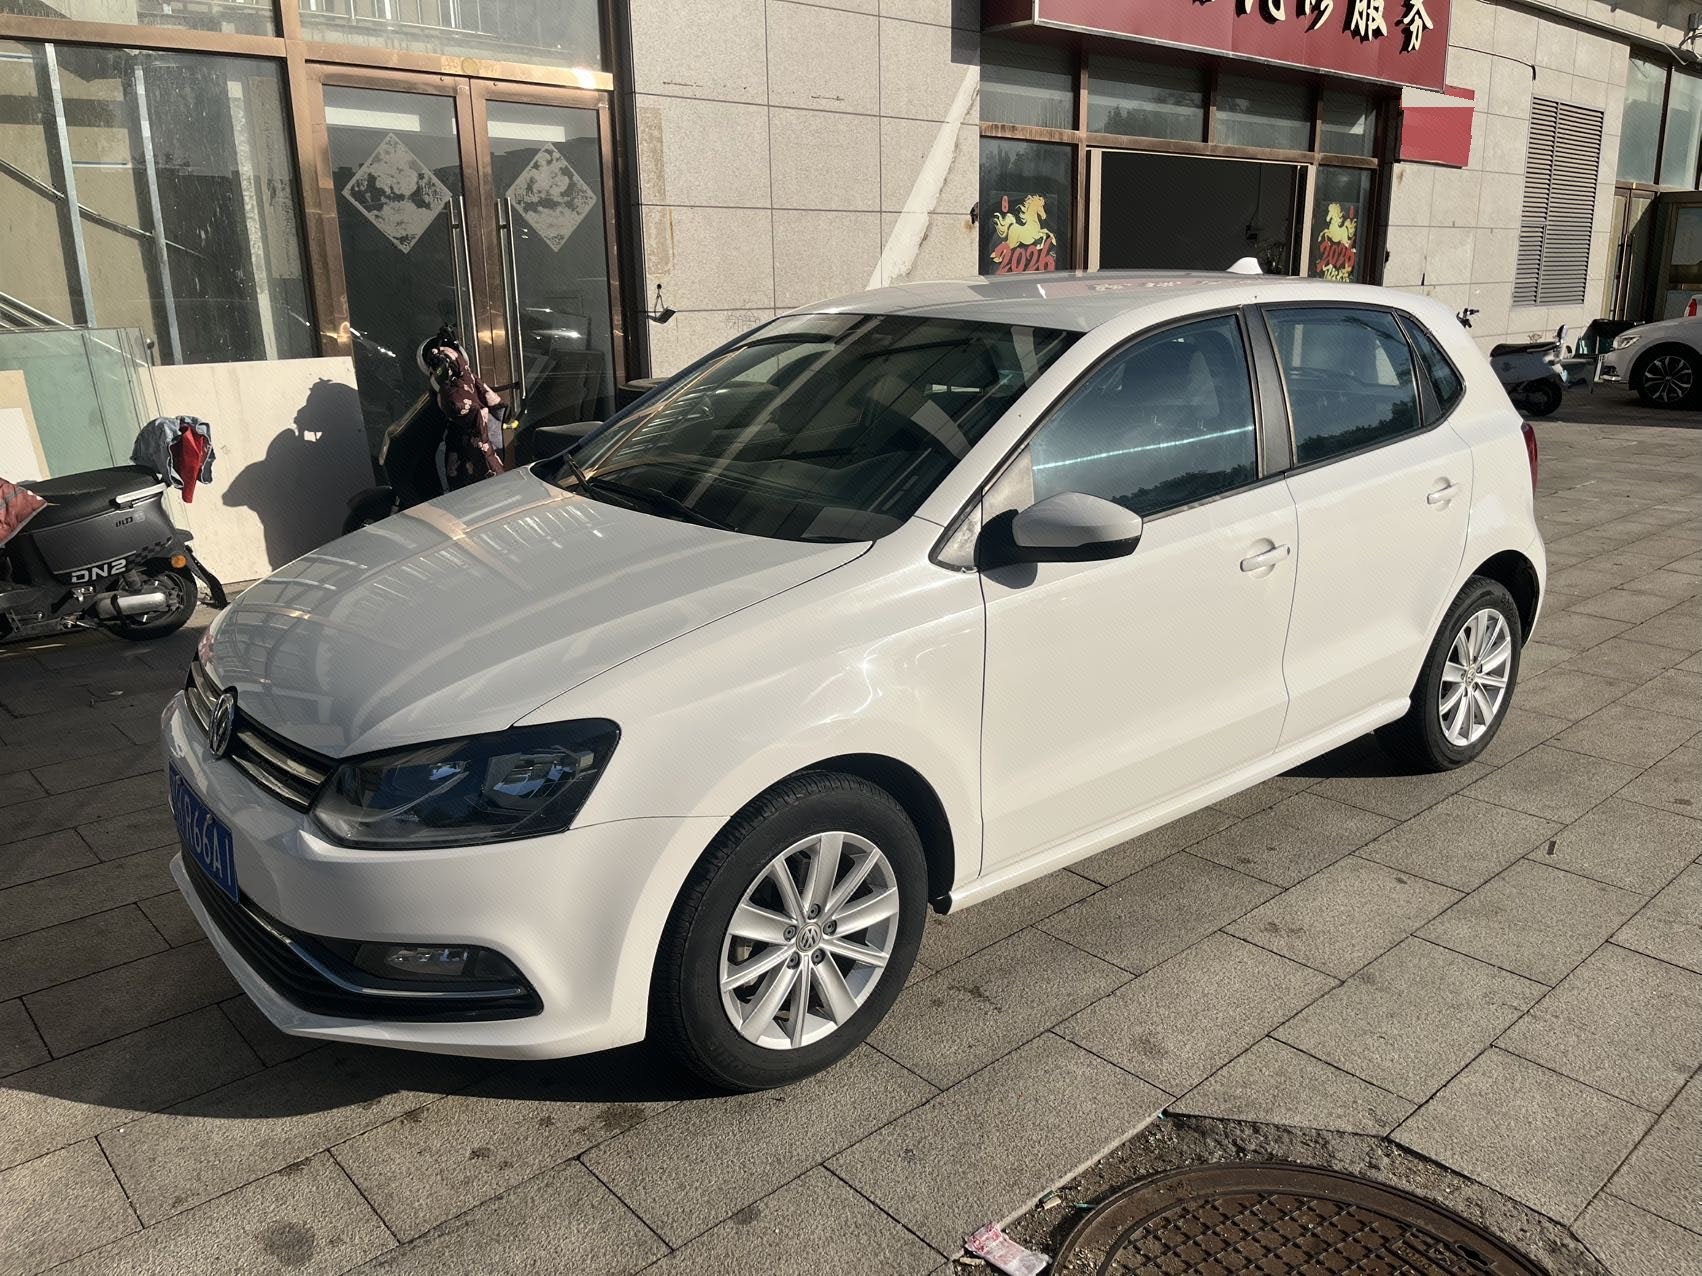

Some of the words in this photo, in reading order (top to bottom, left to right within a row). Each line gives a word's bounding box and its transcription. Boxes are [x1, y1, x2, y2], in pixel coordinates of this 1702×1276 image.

[995, 237, 1056, 274] 2026
[1316, 237, 1356, 273] 2026
[71, 558, 128, 583] DN2
